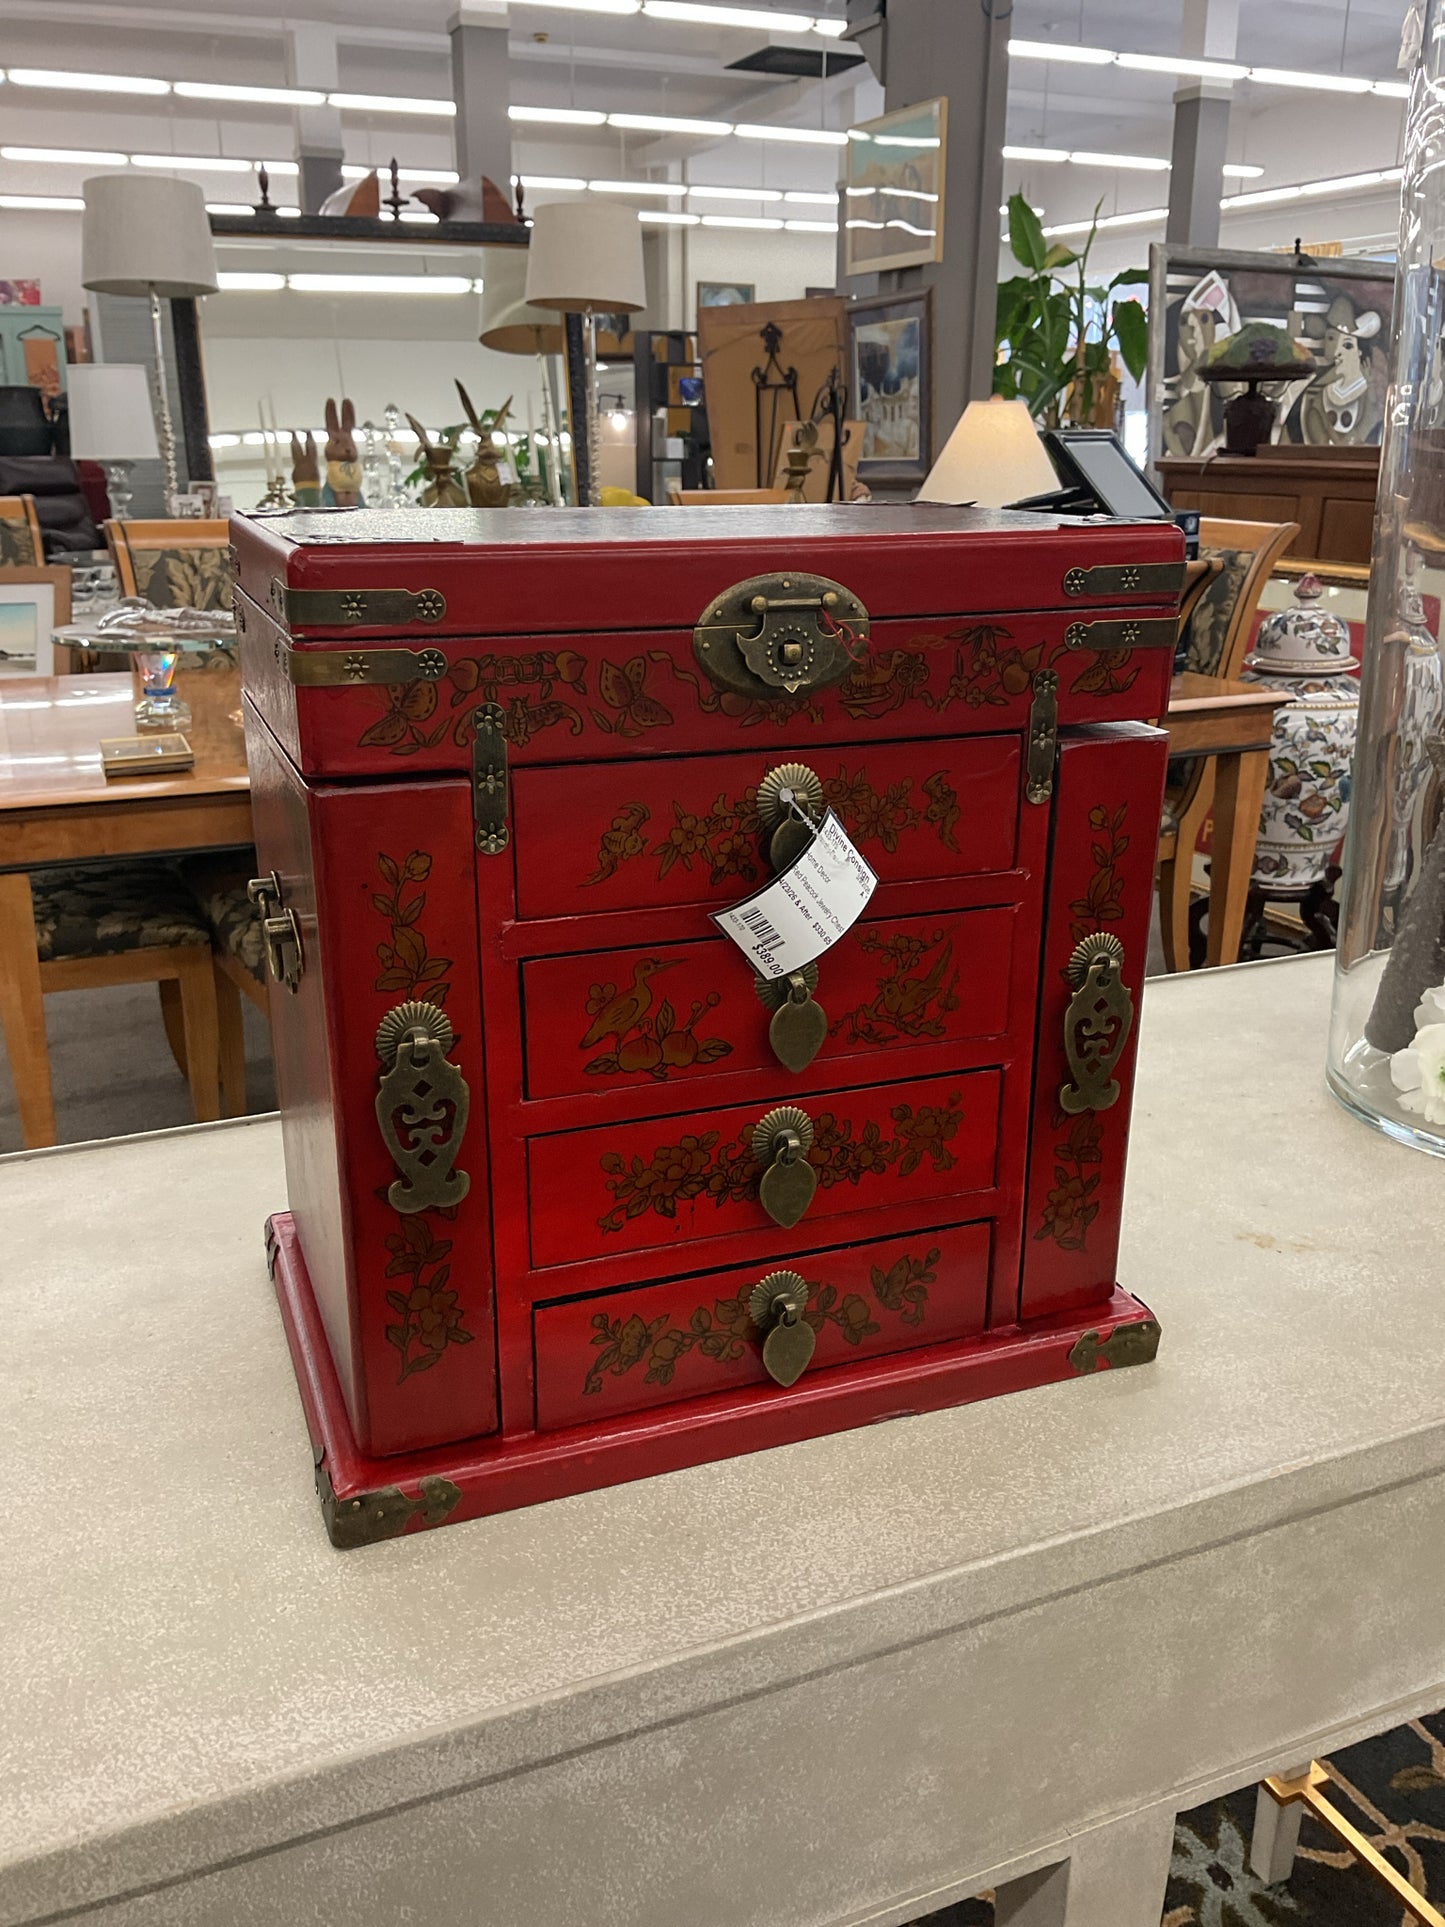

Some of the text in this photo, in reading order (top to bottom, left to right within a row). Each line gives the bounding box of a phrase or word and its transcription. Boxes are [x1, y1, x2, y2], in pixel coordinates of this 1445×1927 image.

[804, 849, 832, 885] Home Decor
[829, 824, 848, 852] Divine
[845, 849, 871, 883] Consign
[777, 877, 832, 946] 4/23/26 & After $330.65
[791, 864, 846, 933] Red Peacock Jewelry Chest
[751, 942, 785, 976] $389.00
